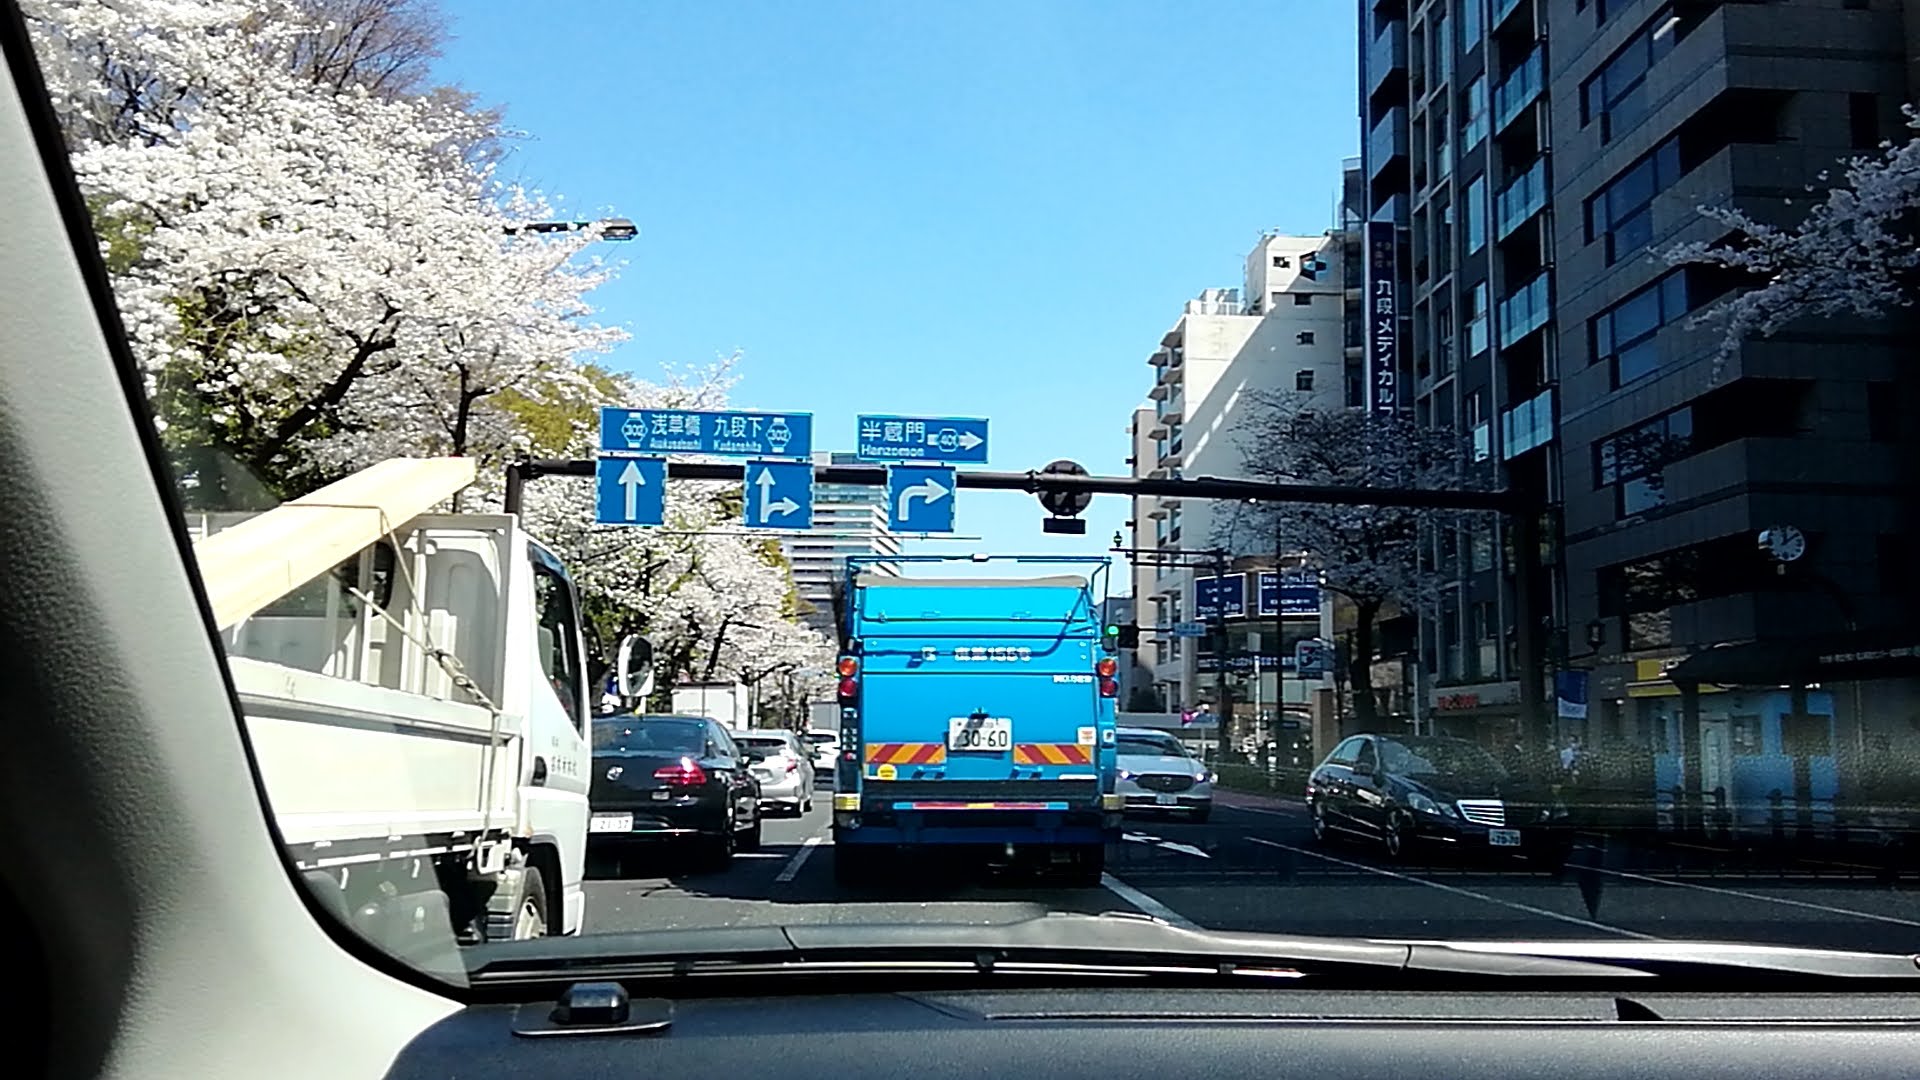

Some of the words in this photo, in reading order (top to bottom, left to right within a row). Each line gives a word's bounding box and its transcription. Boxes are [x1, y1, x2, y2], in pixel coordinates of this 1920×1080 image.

[623, 424, 645, 437] 302
[651, 414, 701, 436] 浅草橋
[714, 416, 764, 438] 九段下
[770, 430, 788, 442] 302
[861, 420, 925, 443] 半蔵門
[861, 443, 925, 457] Hanzomon
[959, 729, 1008, 747] 30-60
